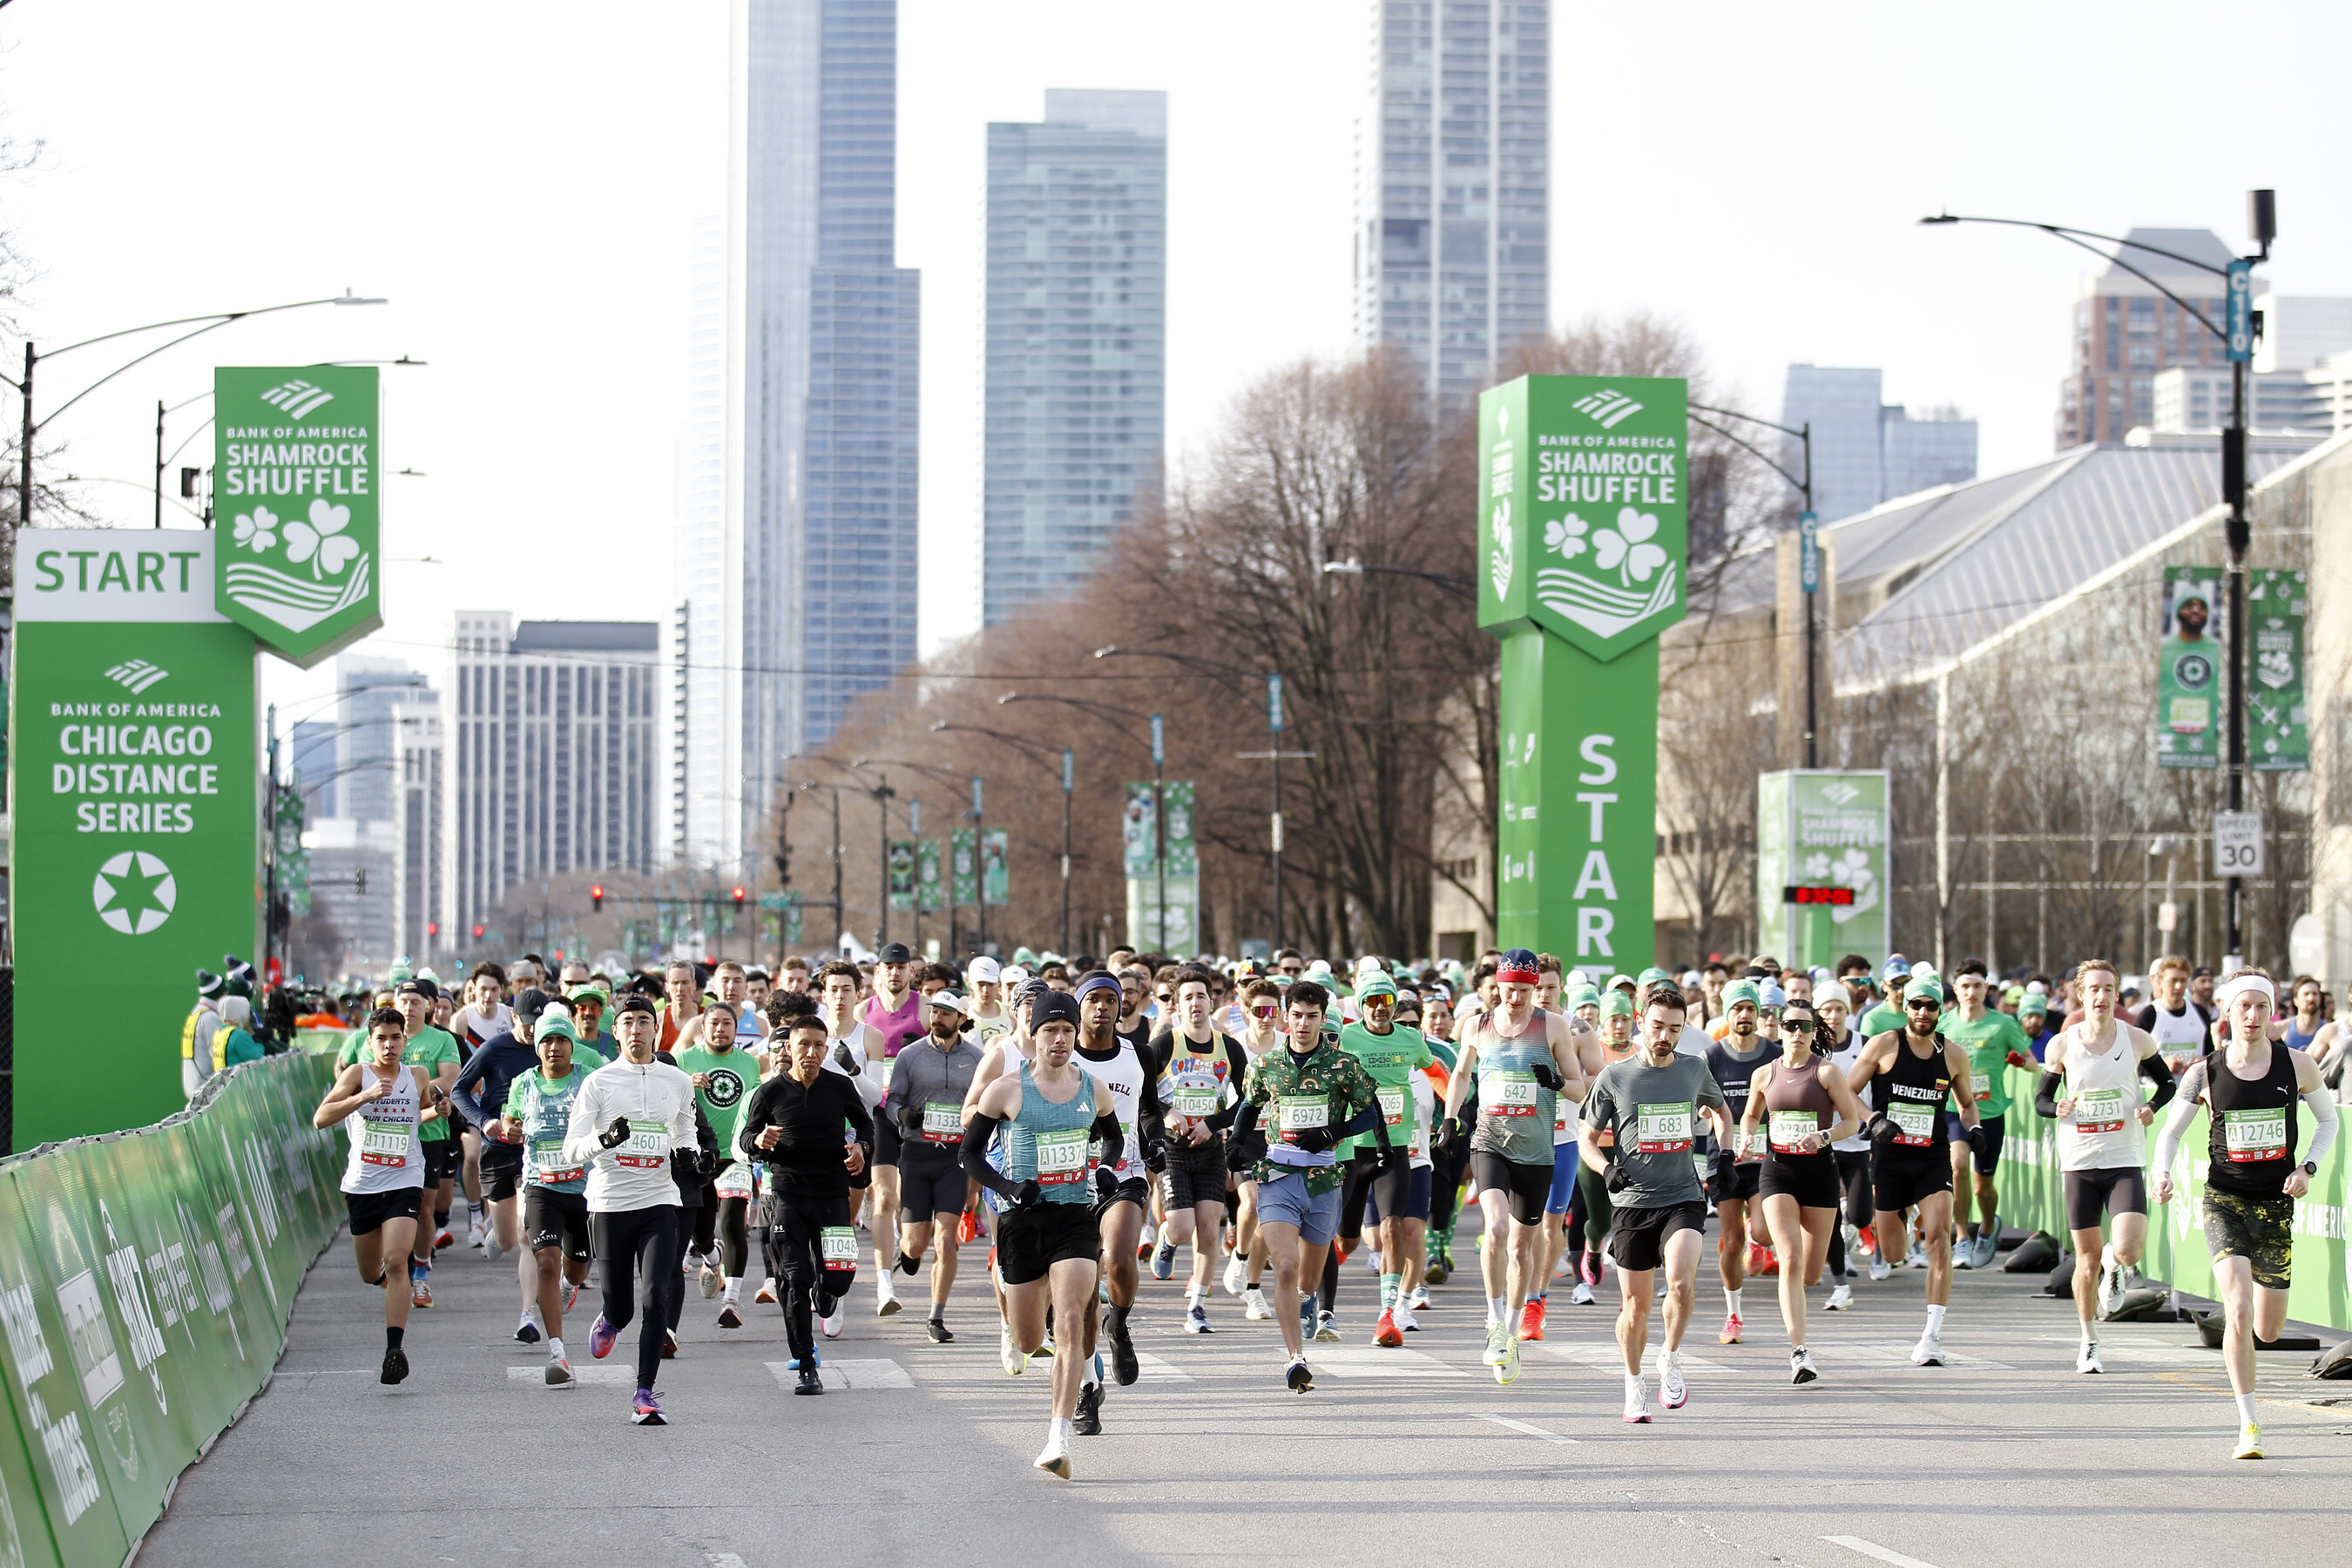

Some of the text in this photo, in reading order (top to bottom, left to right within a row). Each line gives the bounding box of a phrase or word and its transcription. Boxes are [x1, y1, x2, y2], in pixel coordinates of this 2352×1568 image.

[2231, 271, 2248, 353] C110
[226, 427, 368, 438] BANK OF AMERICA
[1538, 436, 1676, 449] BANK OF AMERICA
[226, 443, 368, 466] SHAMROCK
[1538, 451, 1675, 475] SHAMROCK
[226, 467, 368, 496] SHUFFLE
[1538, 476, 1676, 504] SHUFFLE
[35, 551, 200, 593] START
[51, 703, 221, 718] BANK OF AMERICA
[59, 725, 213, 756] CHICAGO
[52, 763, 219, 794] DISTANCE
[77, 802, 194, 834] SERIES
[2218, 820, 2257, 830] SPEED
[1801, 832, 1877, 848] SHUFFLE
[2222, 832, 2252, 841] LIMIT
[2222, 845, 2256, 867] 30
[1108, 1083, 1131, 1096] NELL
[1504, 1085, 1528, 1098] 642
[1892, 1083, 1943, 1100] VENEZUELA
[1183, 1098, 1215, 1111] 10450
[2085, 1101, 2120, 1117] 12731
[1293, 1108, 1322, 1123] 6972
[1901, 1115, 1929, 1130] 6238
[1640, 1117, 1682, 1133] A 683
[2228, 1122, 2283, 1141] A 12746
[374, 1134, 407, 1151] 11119
[632, 1134, 661, 1150] 4601
[546, 1152, 568, 1166] 112
[1041, 1148, 1049, 1165] A
[1051, 1143, 1086, 1164] 13376
[2306, 1202, 2349, 1240] AMERIC
[145, 1252, 180, 1329] FLEET
[167, 1240, 199, 1315] FEET
[105, 1244, 167, 1373] SHOKZ
[31, 1390, 101, 1527] fitness
